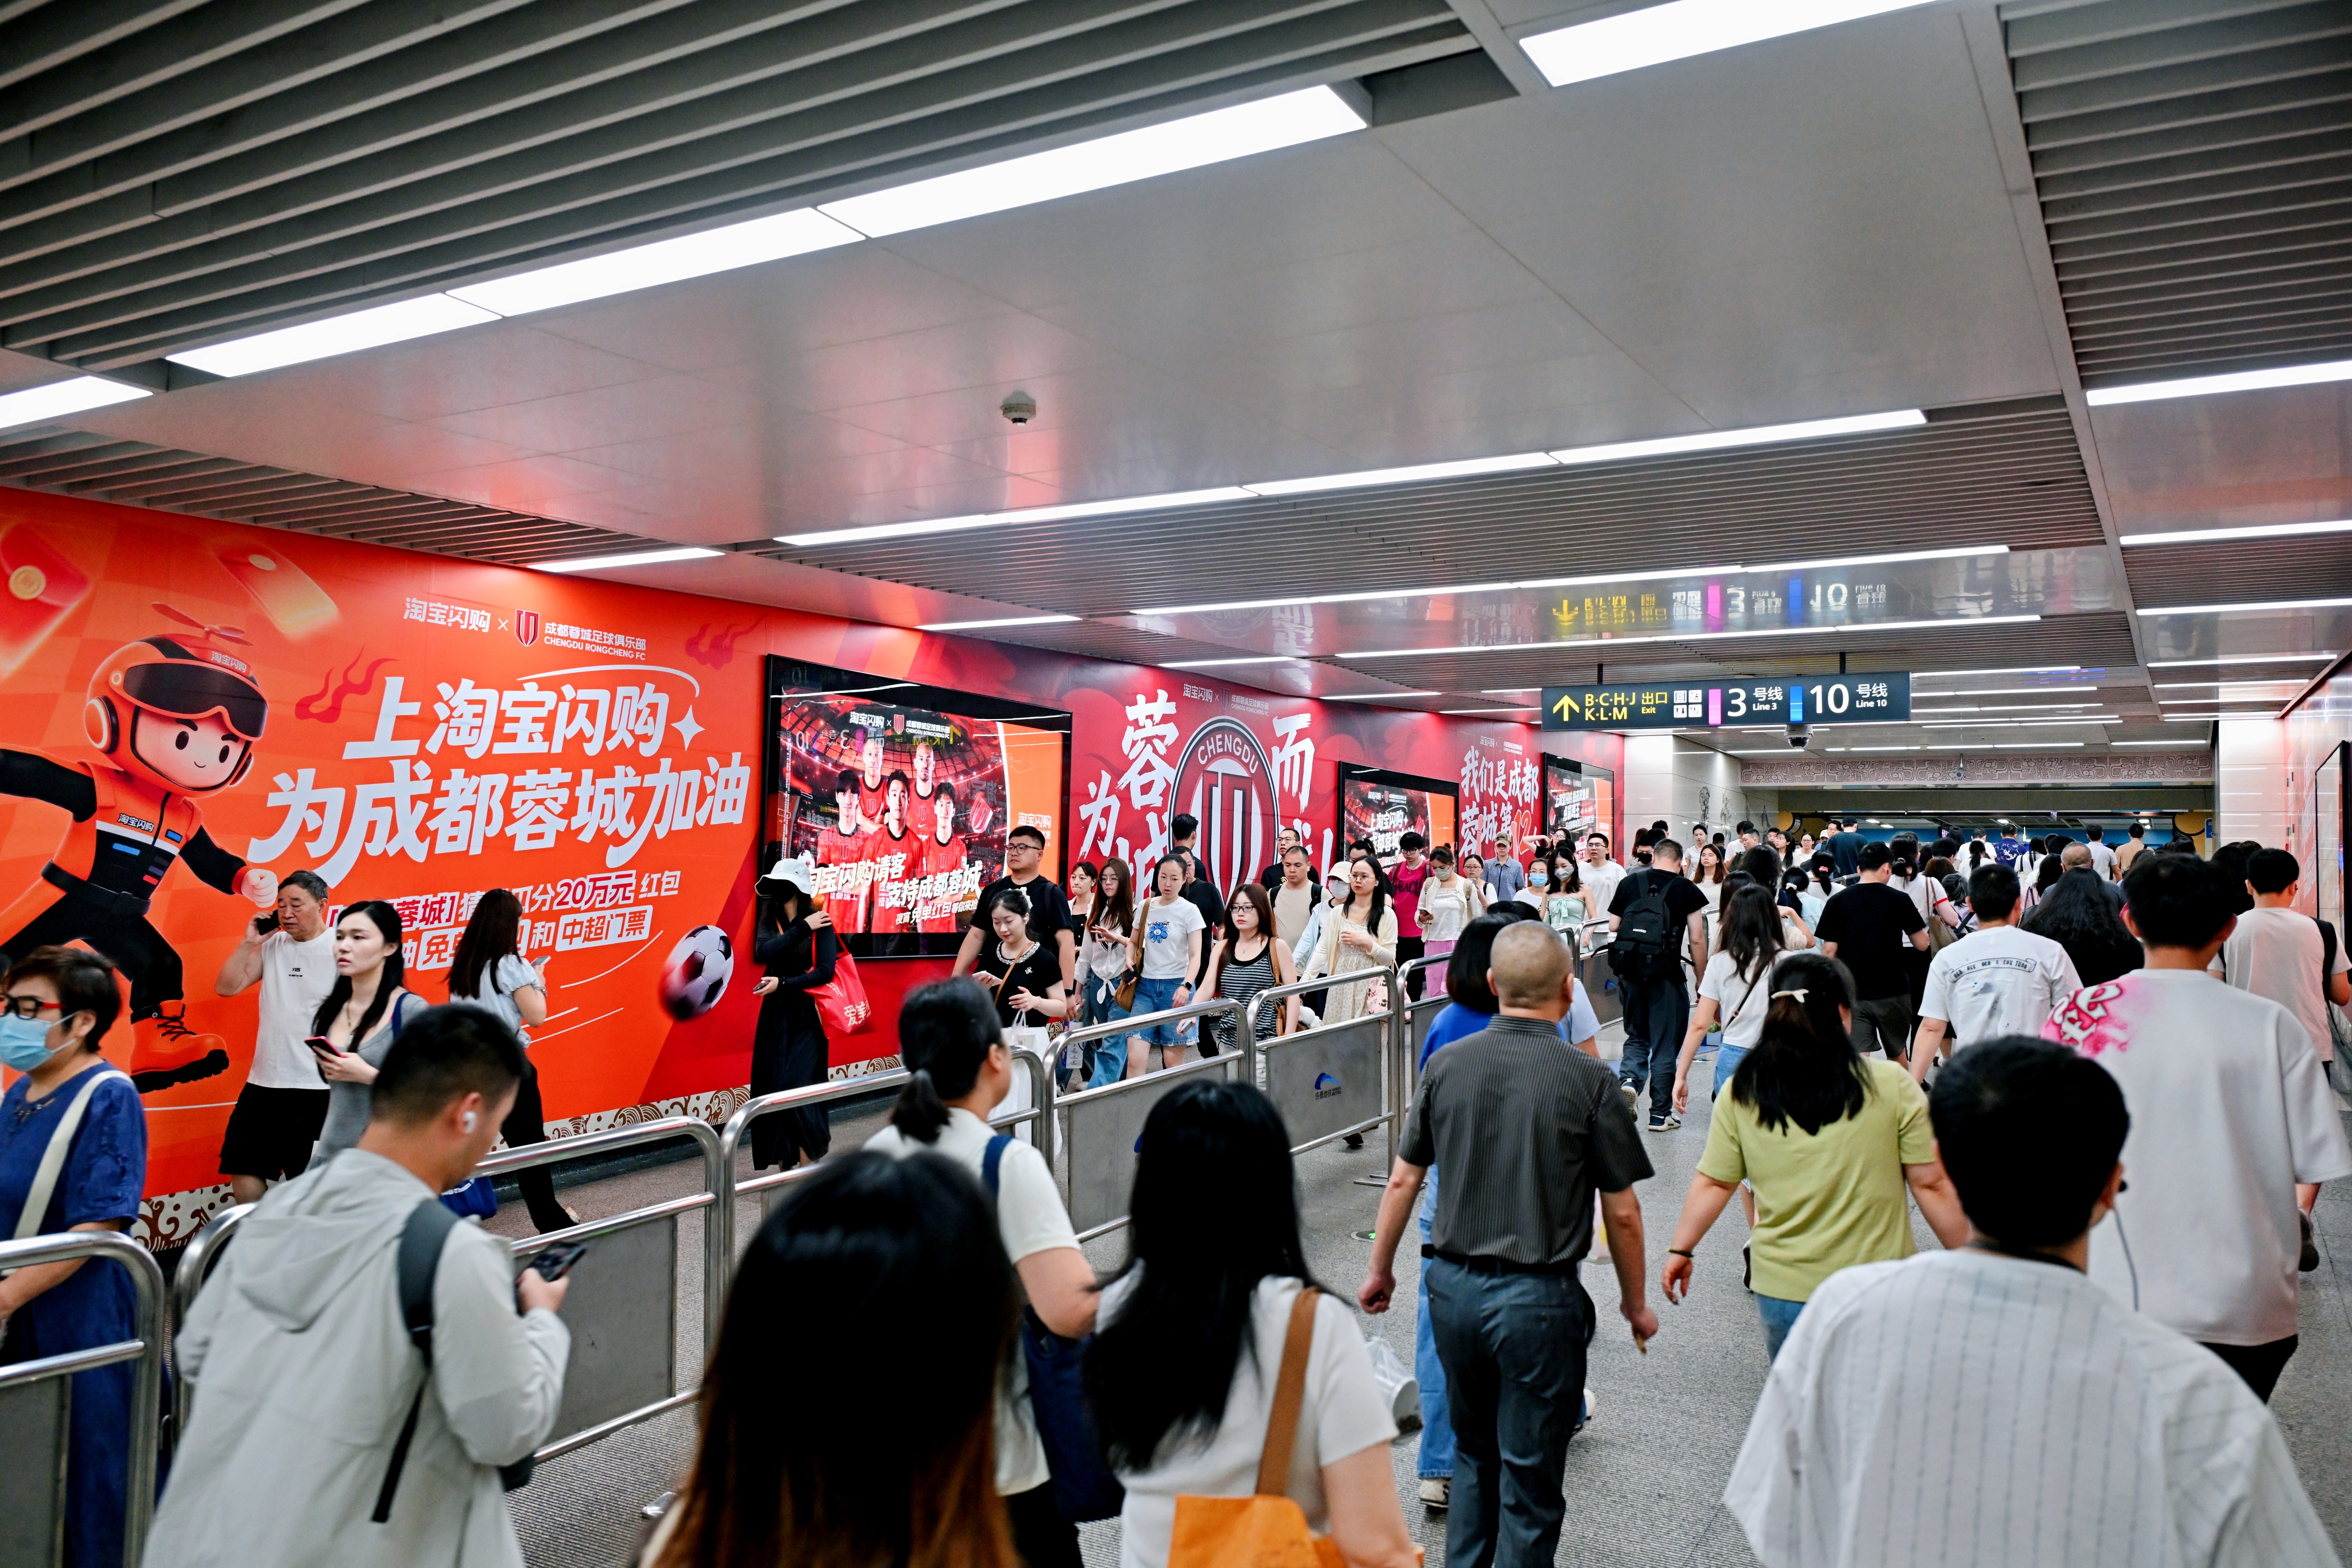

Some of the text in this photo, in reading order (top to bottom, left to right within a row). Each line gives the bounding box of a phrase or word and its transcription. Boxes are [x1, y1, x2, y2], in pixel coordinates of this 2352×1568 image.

[403, 597, 491, 633] 淘宝闪购
[544, 622, 646, 651] 成都蓉城足球俱乐部
[544, 636, 646, 661] CHENGDU RONGCHENG FC
[211, 650, 247, 673] 淘宝闪购
[1183, 684, 1212, 702] 淘宝闪购
[1231, 695, 1269, 710] 成都蓉城足球俱乐部
[1642, 691, 1668, 705] 出口
[1728, 688, 1746, 717] 3
[1753, 686, 1783, 701] 号线
[1810, 684, 1849, 713] 10
[1856, 683, 1888, 698] 号线
[342, 676, 670, 759] 上淘宝闪购
[849, 711, 884, 728] 淘宝闪购
[906, 720, 950, 733] 成都蓉城足球俱乐部
[1246, 706, 1264, 715] RONGCHENG
[1198, 733, 1259, 774] CHENGDU
[1480, 735, 1495, 748] 淘宝闪购
[1461, 745, 1539, 815] 我们是成都
[117, 813, 154, 833] 淘宝闪购
[247, 752, 751, 889] 为成都蓉城加油
[1018, 812, 1052, 828] 淘宝闪购
[1368, 809, 1404, 833] 上淘宝闪购
[885, 860, 983, 910] 支持成都蓉城
